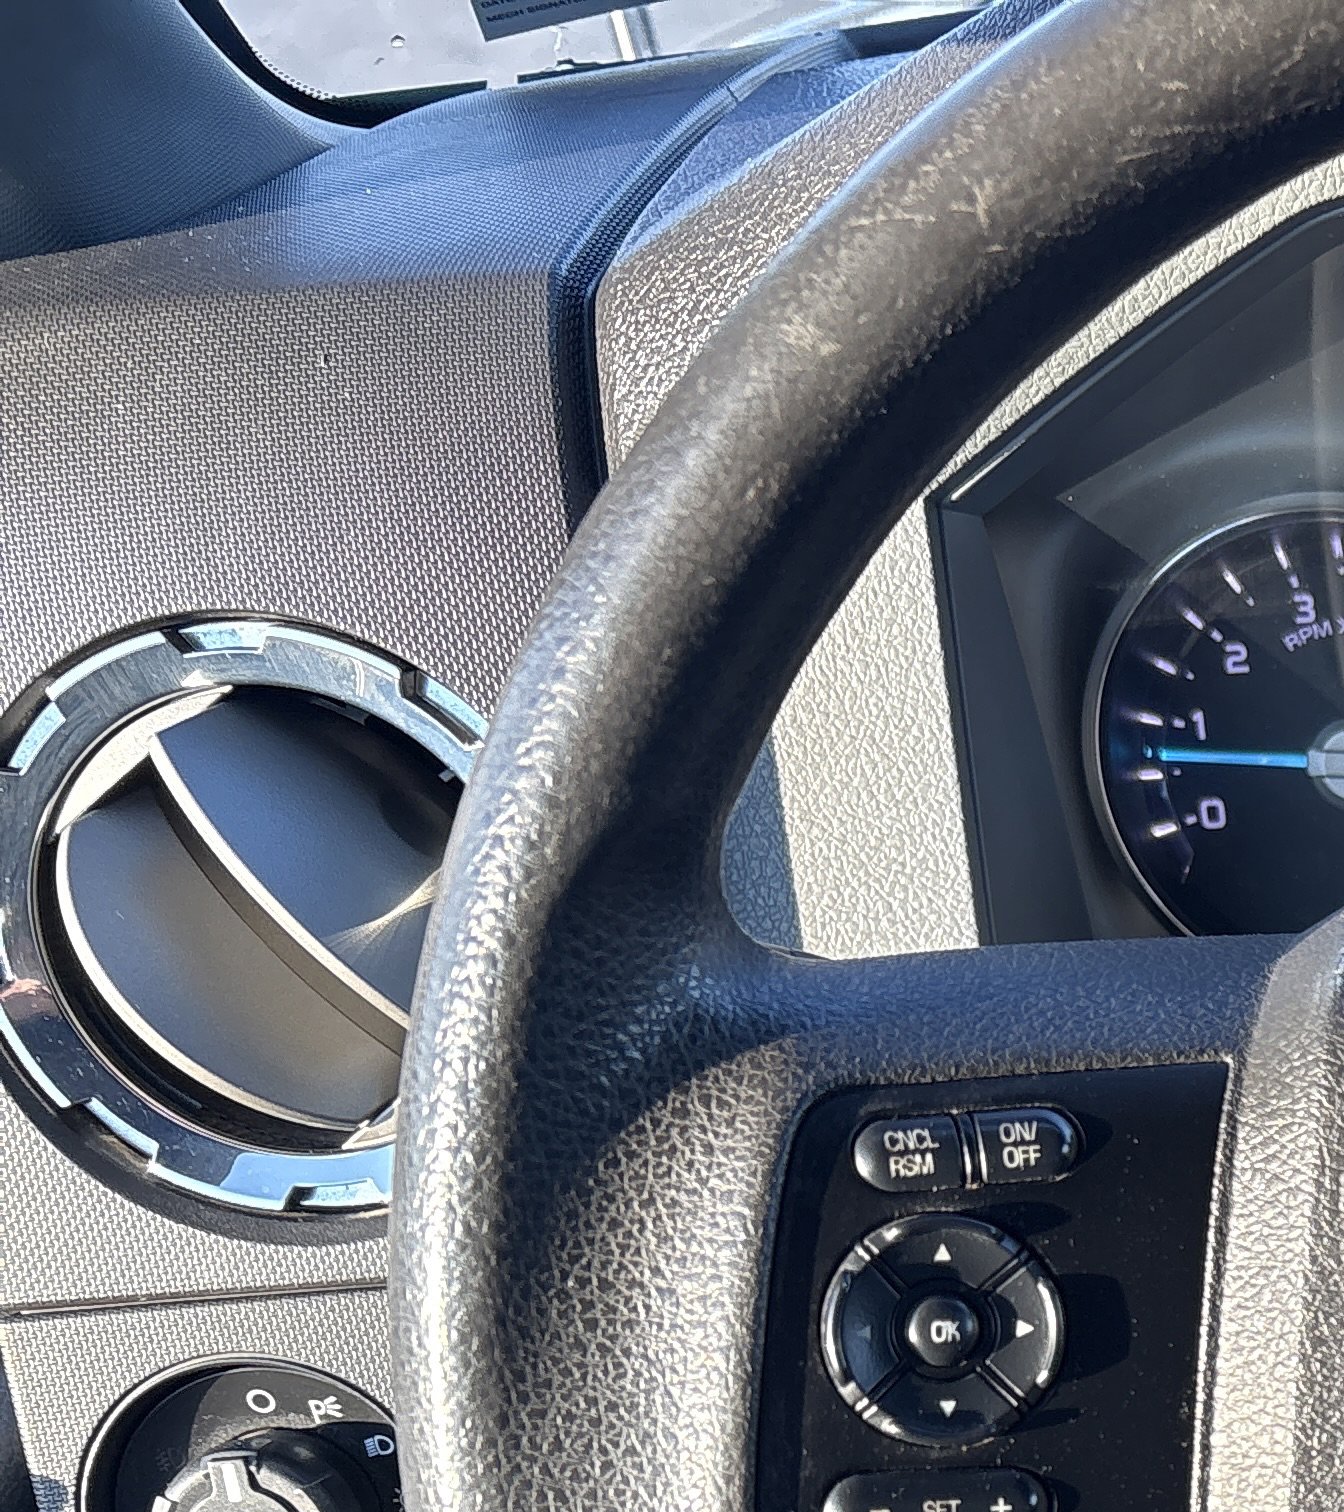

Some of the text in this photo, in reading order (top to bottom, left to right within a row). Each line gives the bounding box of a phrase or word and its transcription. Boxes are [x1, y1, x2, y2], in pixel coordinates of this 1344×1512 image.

[1292, 591, 1317, 625] 3
[1282, 619, 1333, 652] RPM
[1223, 642, 1250, 675] 2
[1190, 709, 1207, 741] 1
[1200, 799, 1227, 830] 0
[883, 1128, 939, 1153] CNCL
[889, 1153, 935, 1179] RSM
[1002, 1145, 1042, 1169] OFF
[930, 1318, 961, 1344] OK
